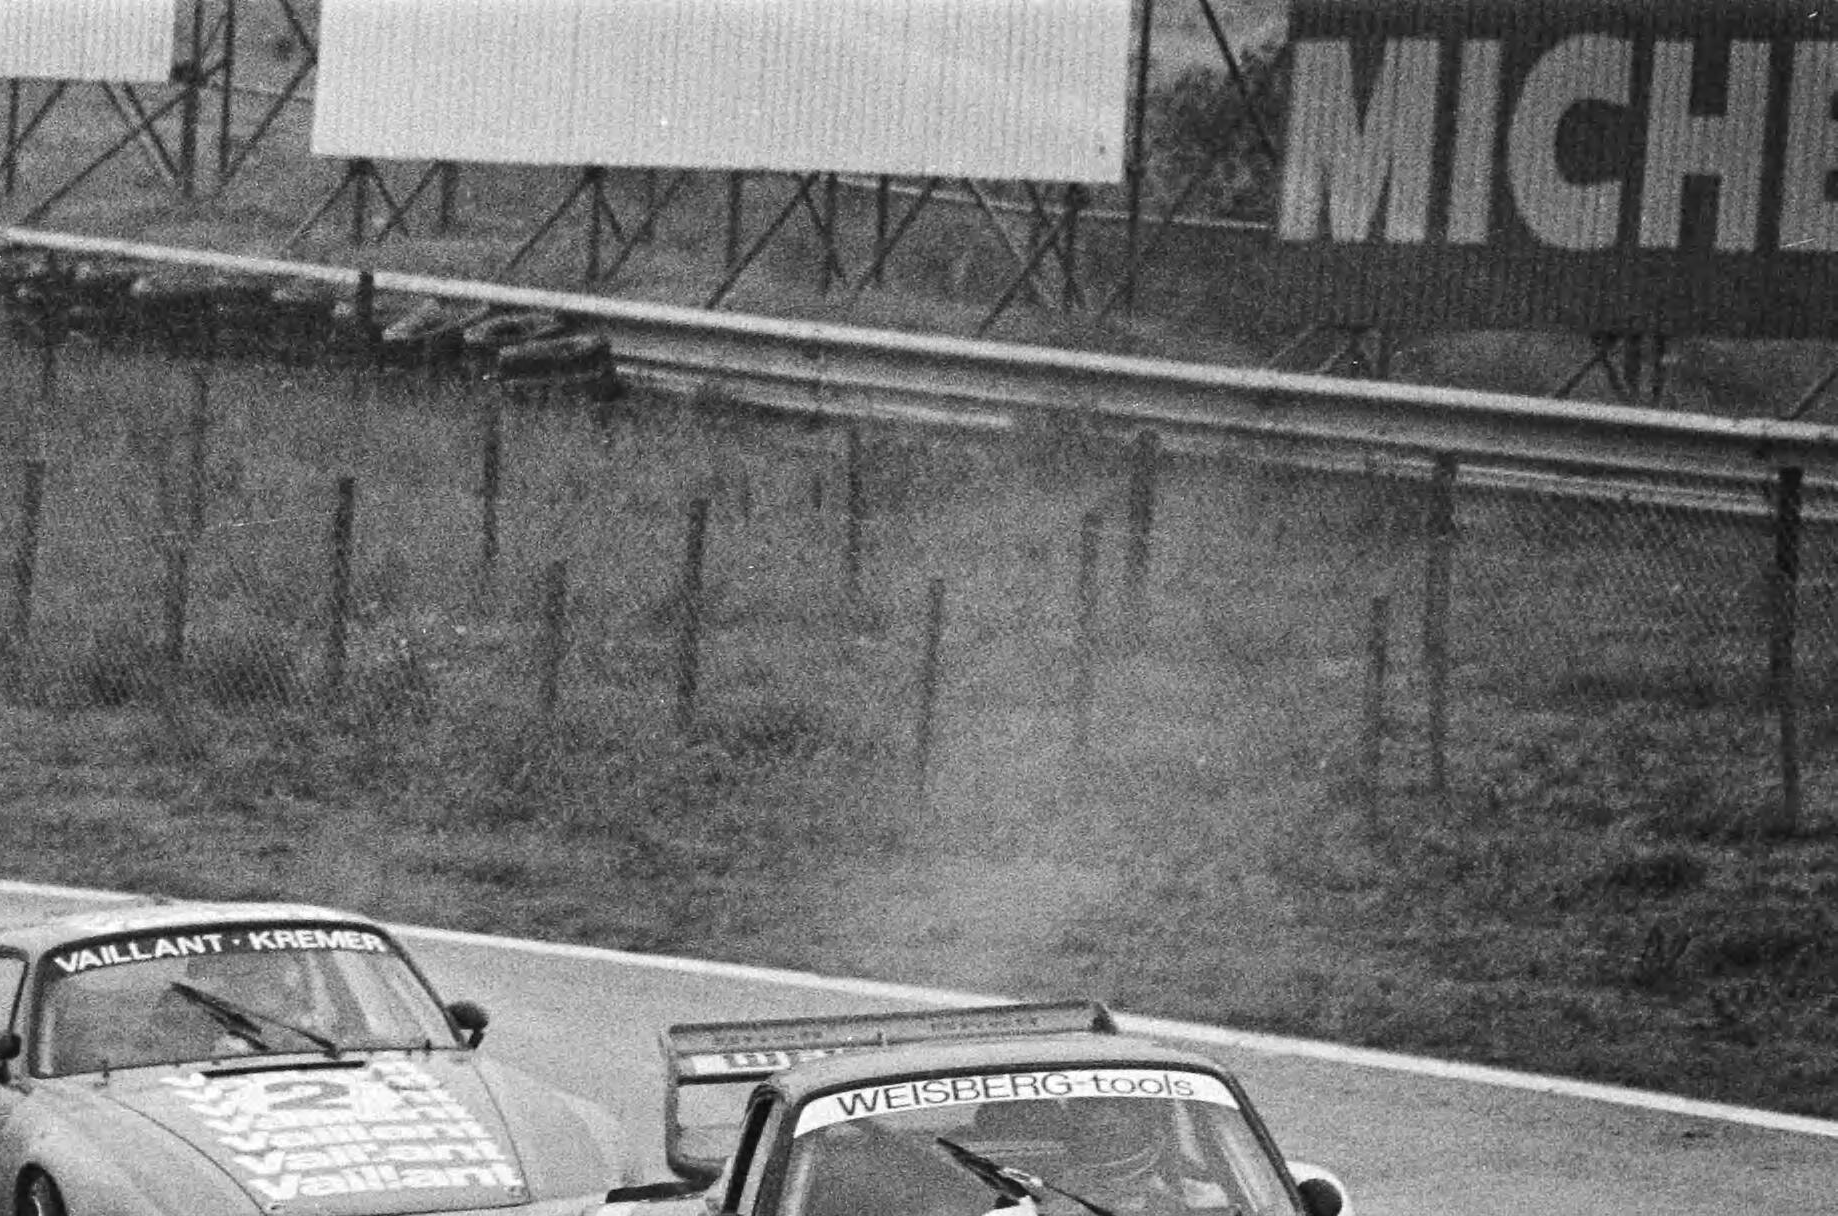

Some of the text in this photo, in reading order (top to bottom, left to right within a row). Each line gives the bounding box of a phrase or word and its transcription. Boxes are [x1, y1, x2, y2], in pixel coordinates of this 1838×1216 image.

[54, 929, 387, 973] VAILLANT KREMER
[264, 1080, 352, 1110] 2
[248, 1162, 524, 1201] Vaillant
